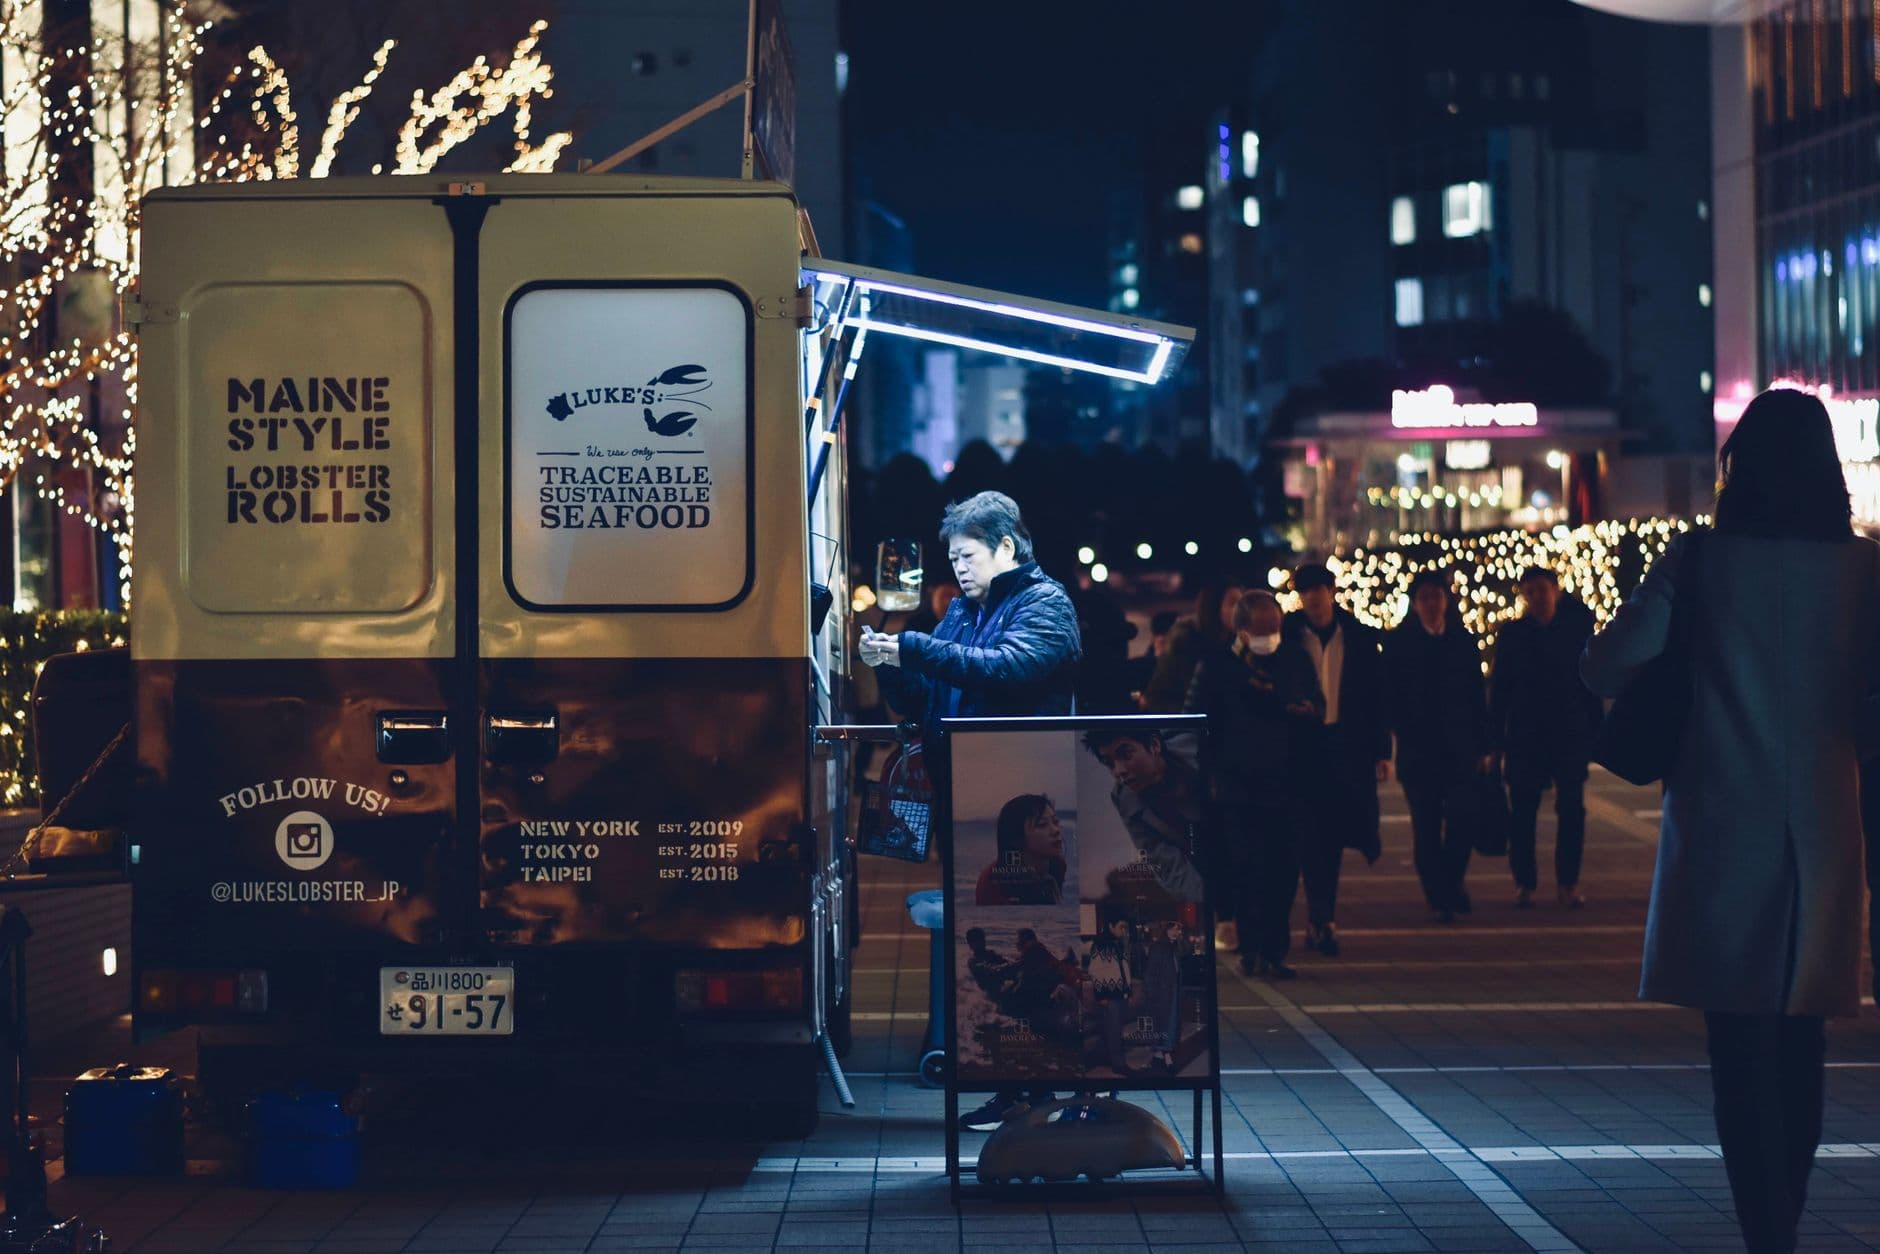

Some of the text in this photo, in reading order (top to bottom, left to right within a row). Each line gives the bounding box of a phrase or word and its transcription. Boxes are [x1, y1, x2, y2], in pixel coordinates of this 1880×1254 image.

[228, 377, 390, 413] MAINE
[228, 417, 390, 451] STYLE
[586, 445, 656, 460] We use only
[227, 465, 391, 490] LOBSTER
[228, 490, 391, 524] ROLLS
[540, 486, 711, 503] SUSTAINABLE
[540, 504, 711, 529] SEAFOOD
[218, 777, 391, 818] FOLLOW US!
[519, 820, 744, 837] NEW YORK EST. 2009
[520, 843, 739, 860] TOKYO EST. 2015
[520, 866, 740, 882] TAIPEI EST. 2018
[211, 880, 401, 903] @LUKESLOBSTER_JP
[387, 994, 507, 1030] せ 91-57
